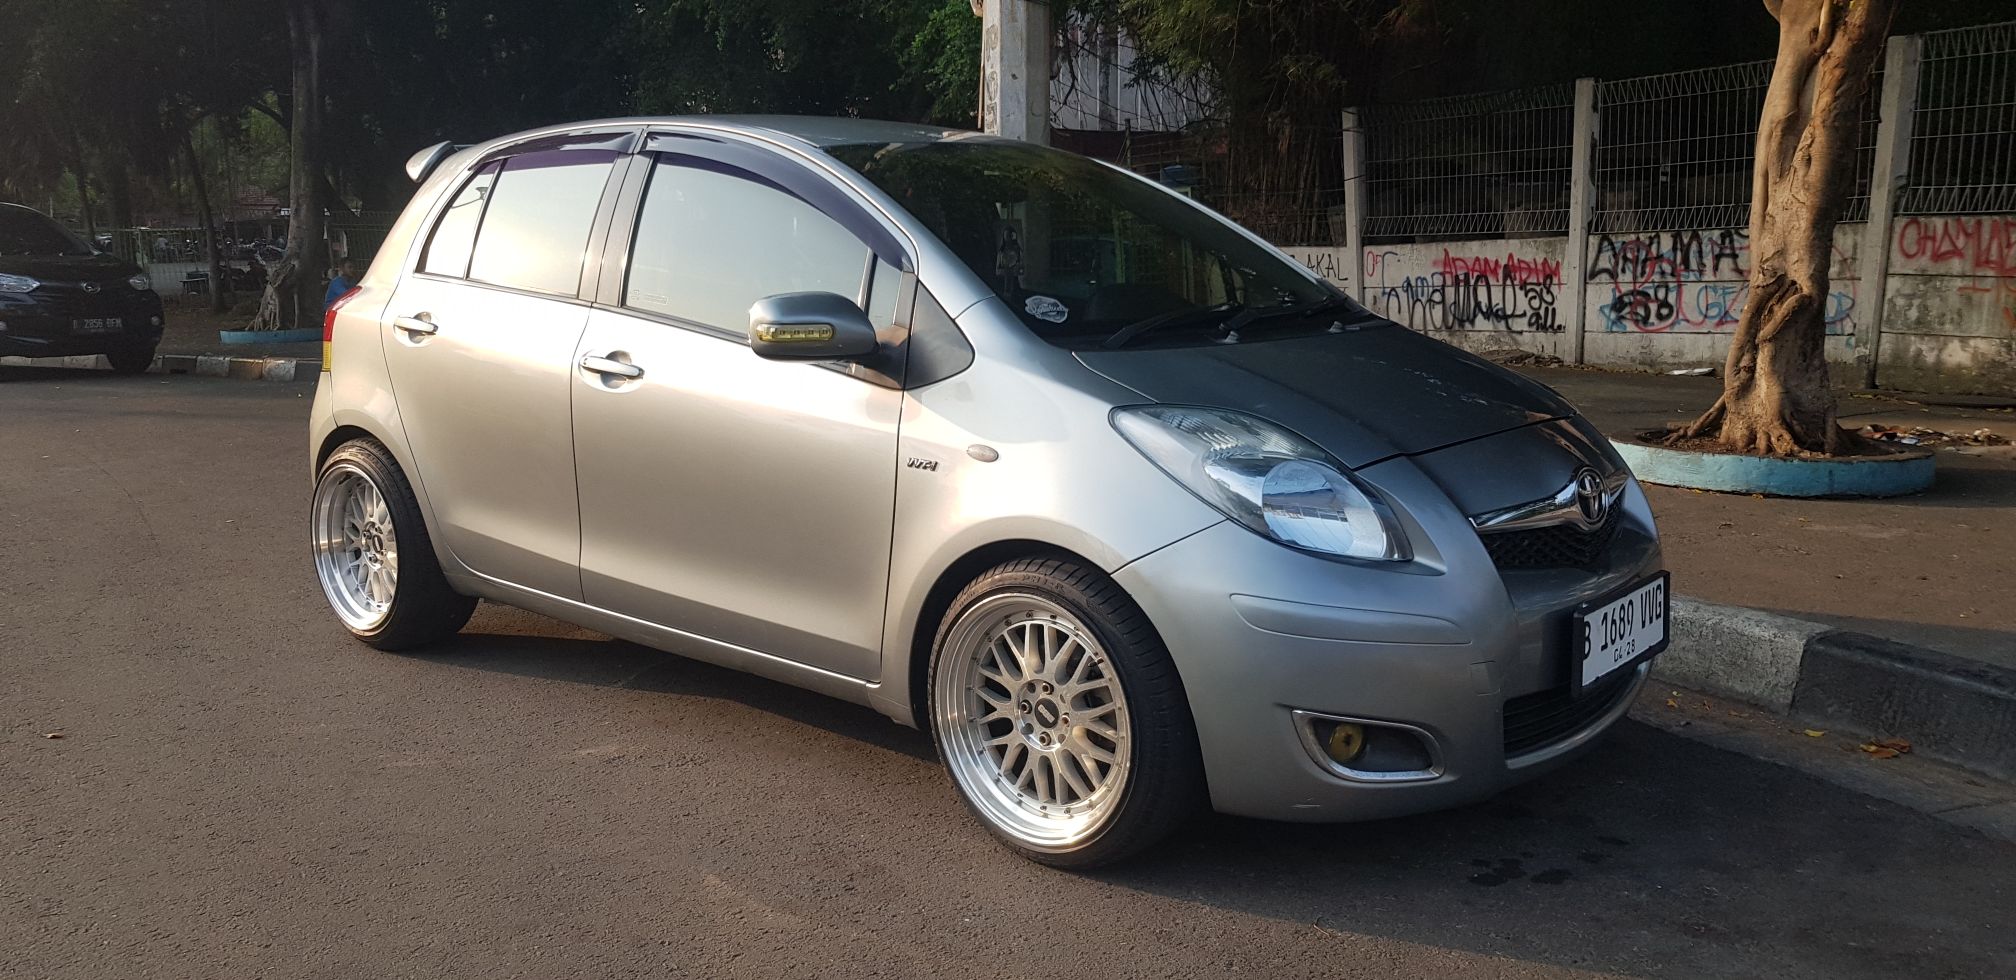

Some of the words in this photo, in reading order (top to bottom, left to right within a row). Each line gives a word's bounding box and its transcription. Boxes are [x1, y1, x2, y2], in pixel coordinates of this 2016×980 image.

[1584, 620, 1591, 660] B
[1600, 599, 1634, 651] 1689
[1640, 583, 1662, 629] VVG
